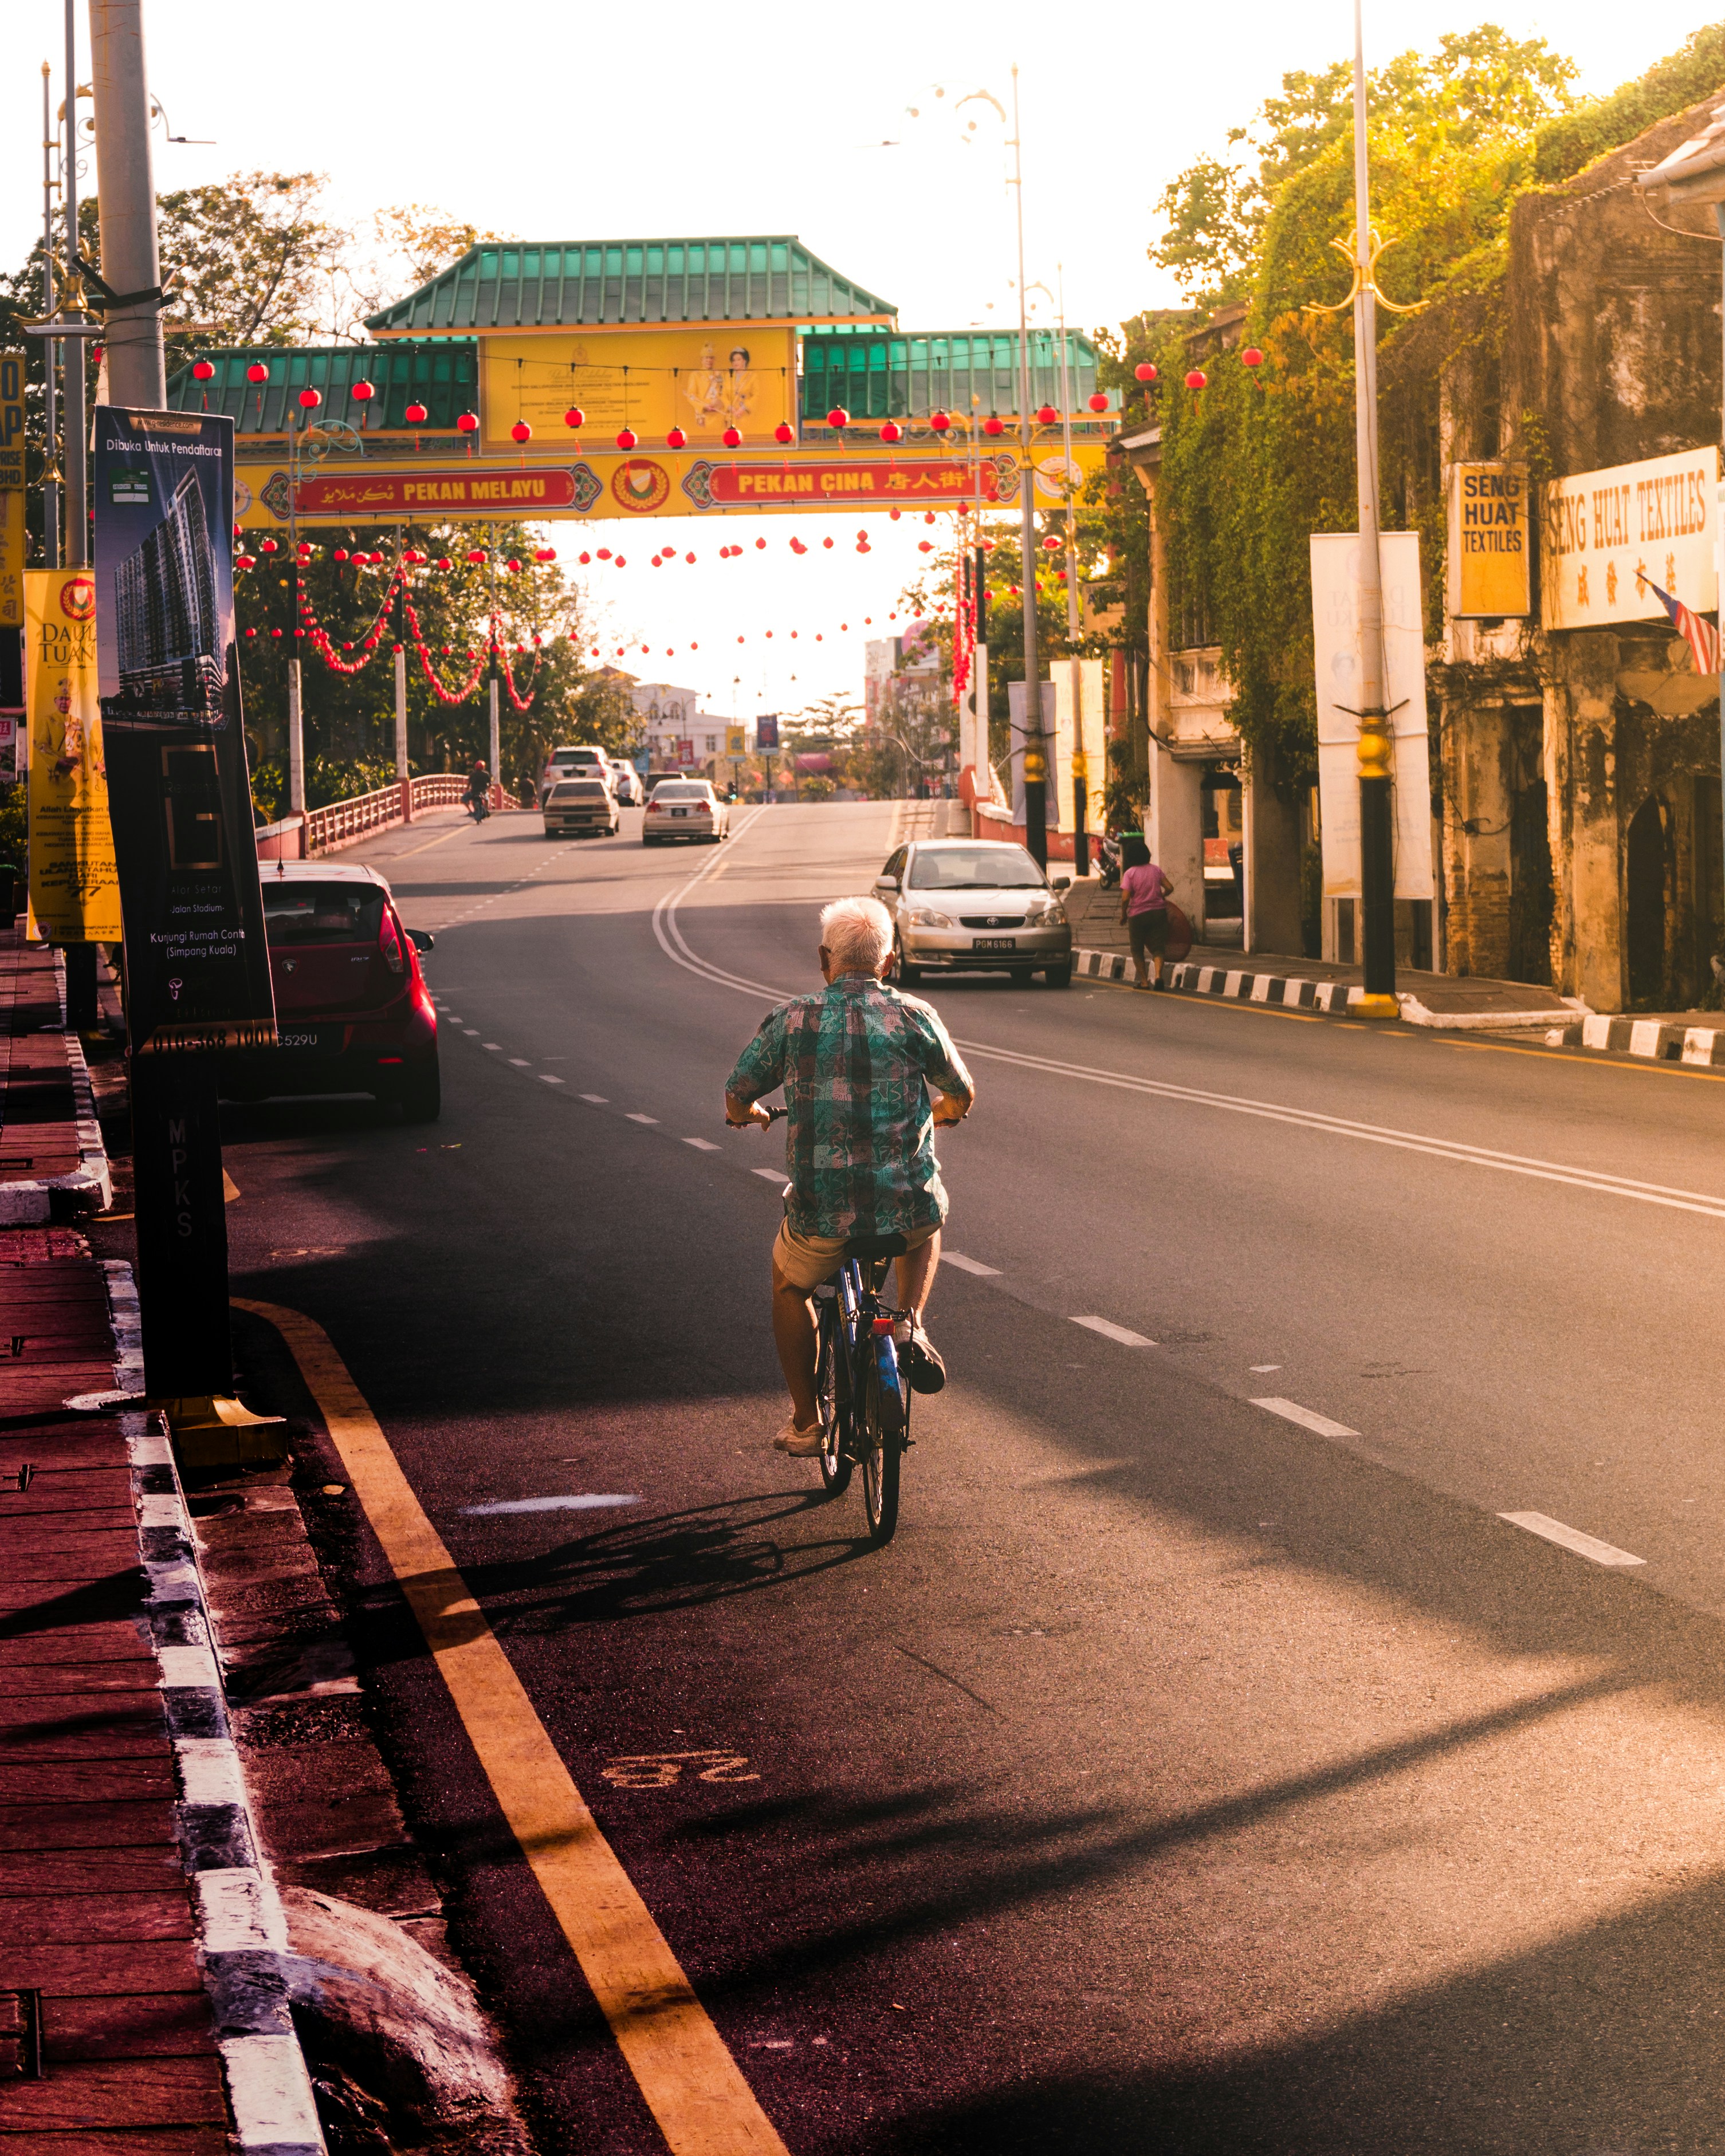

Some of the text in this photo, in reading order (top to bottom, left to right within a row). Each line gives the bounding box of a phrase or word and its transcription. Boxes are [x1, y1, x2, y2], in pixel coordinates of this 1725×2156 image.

[107, 439, 142, 451] Dibuka
[144, 440, 170, 453] Untuk
[738, 473, 875, 493] PEKAN CINA
[884, 471, 967, 489] 唐人街
[1464, 475, 1519, 497] SENG
[404, 479, 545, 501] PEKAN MELAYU
[1465, 502, 1519, 525] HUAT
[1549, 469, 1706, 556] SENG HUAT TEXTILES
[1463, 530, 1522, 553] TEXTILES
[43, 624, 96, 642] DAUL
[67, 886, 101, 898] 77
[171, 884, 222, 894] Alor Setar
[150, 931, 187, 944] Kunjungi
[189, 930, 218, 941] Rumah
[976, 940, 992, 949] PGM
[166, 943, 236, 959] (Simpang Kuala)
[153, 1026, 272, 1054] 010-368 1001
